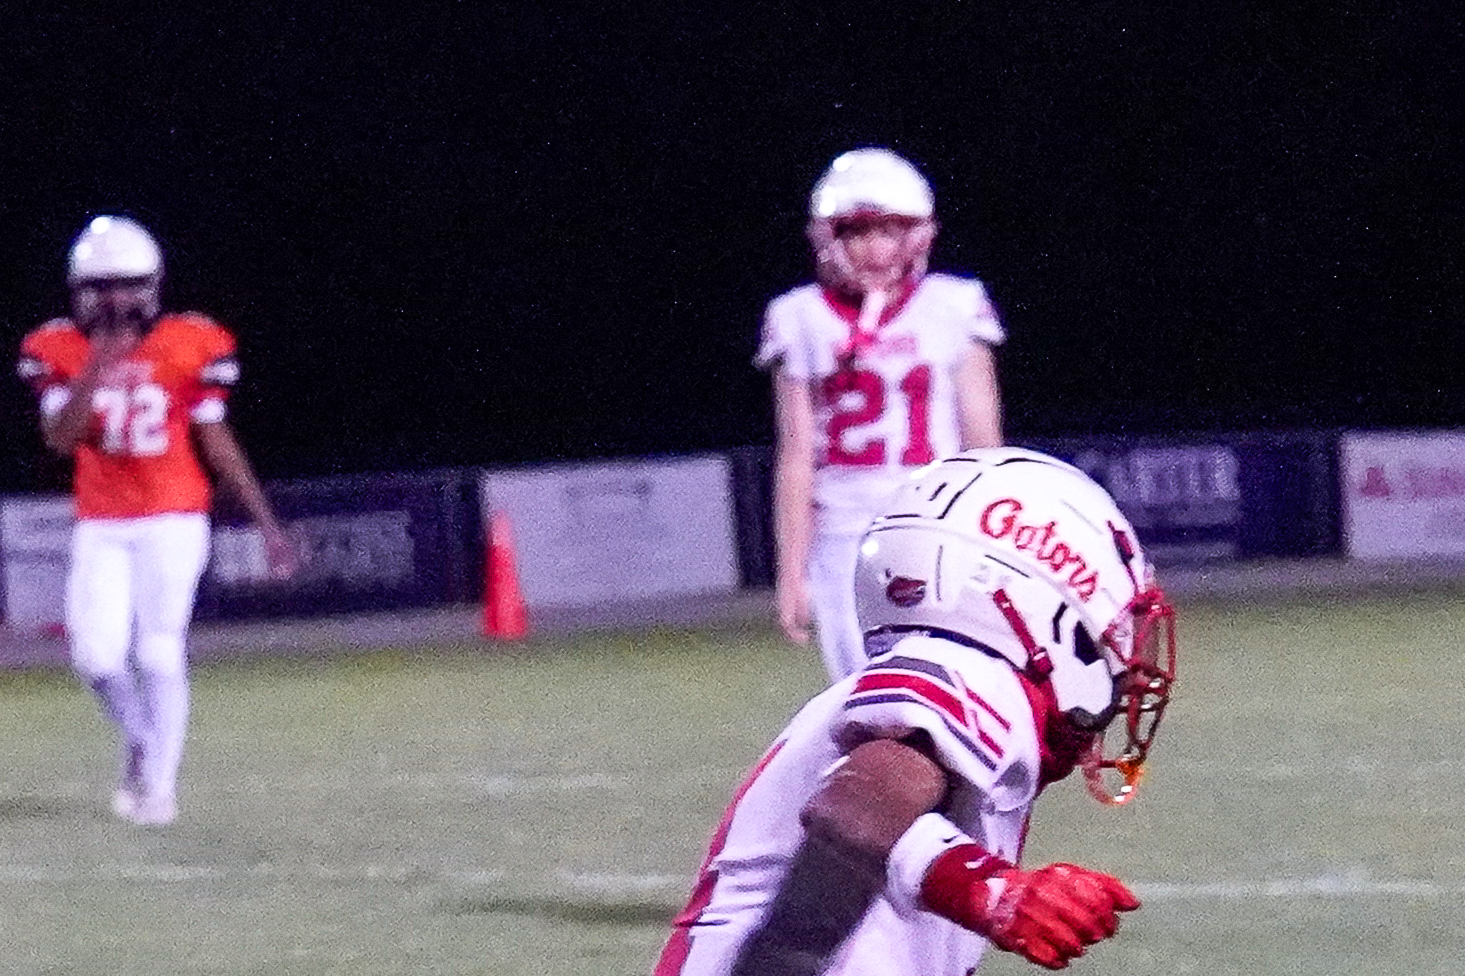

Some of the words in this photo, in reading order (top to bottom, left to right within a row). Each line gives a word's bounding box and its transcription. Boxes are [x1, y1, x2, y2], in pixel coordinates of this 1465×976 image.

[91, 384, 169, 457] 72
[822, 364, 934, 466] 21
[979, 498, 1098, 602] Gators
